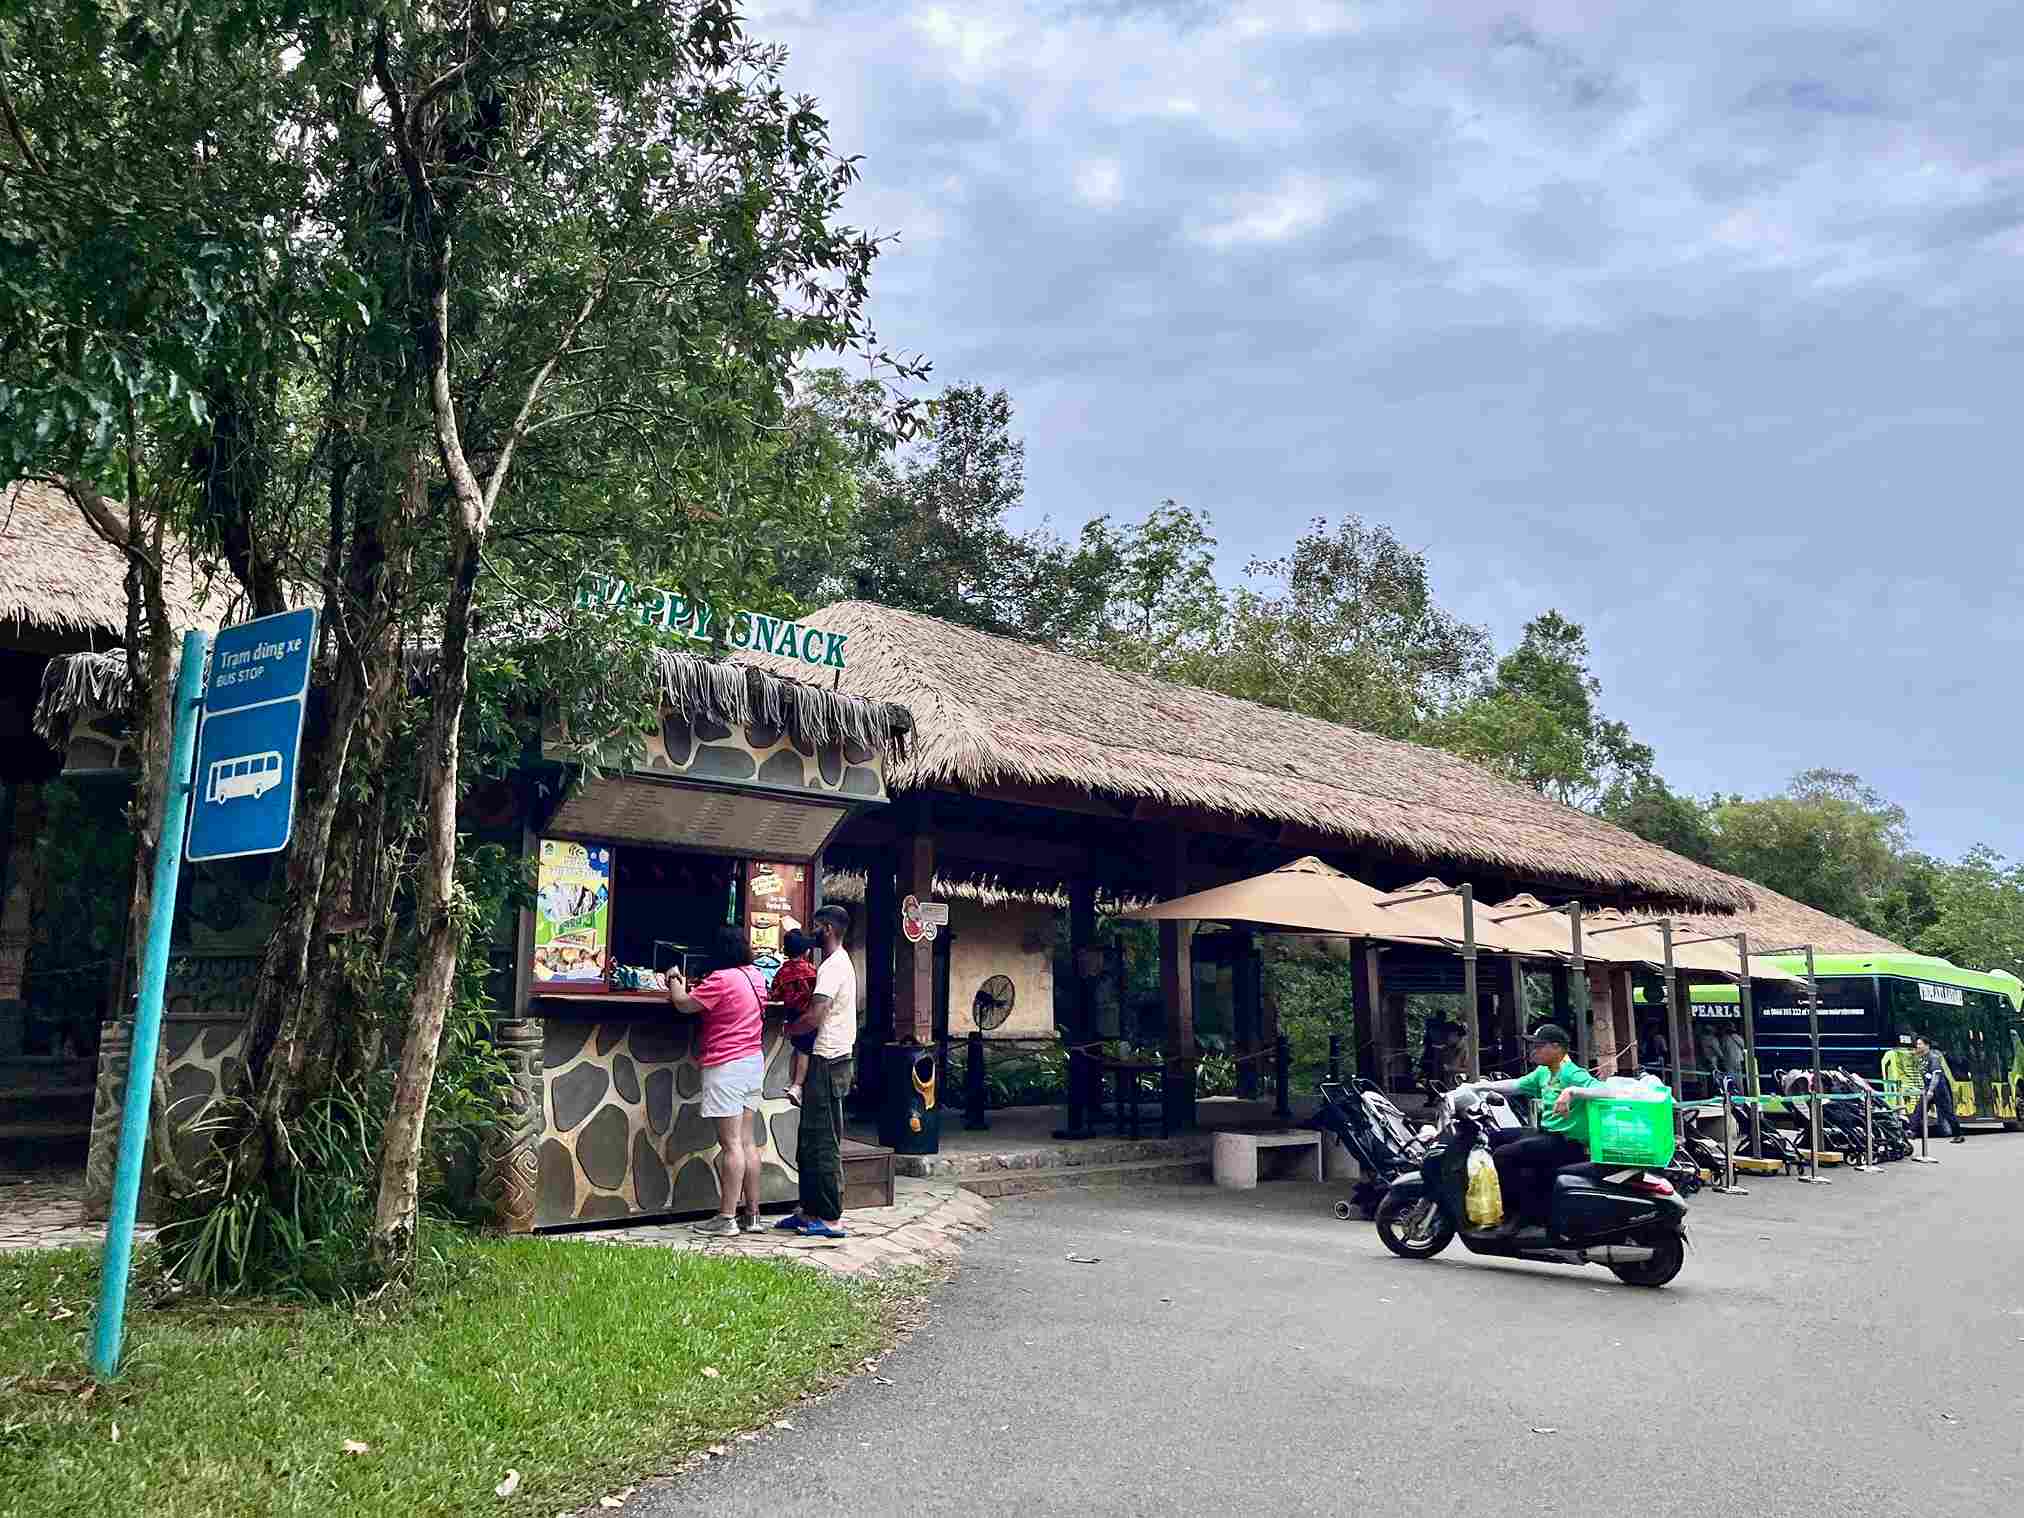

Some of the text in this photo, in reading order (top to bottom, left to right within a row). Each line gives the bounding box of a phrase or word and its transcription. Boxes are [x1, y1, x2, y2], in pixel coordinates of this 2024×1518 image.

[286, 638, 302, 653] xe
[727, 610, 850, 669] SNACK
[216, 665, 264, 688] BUS STOP
